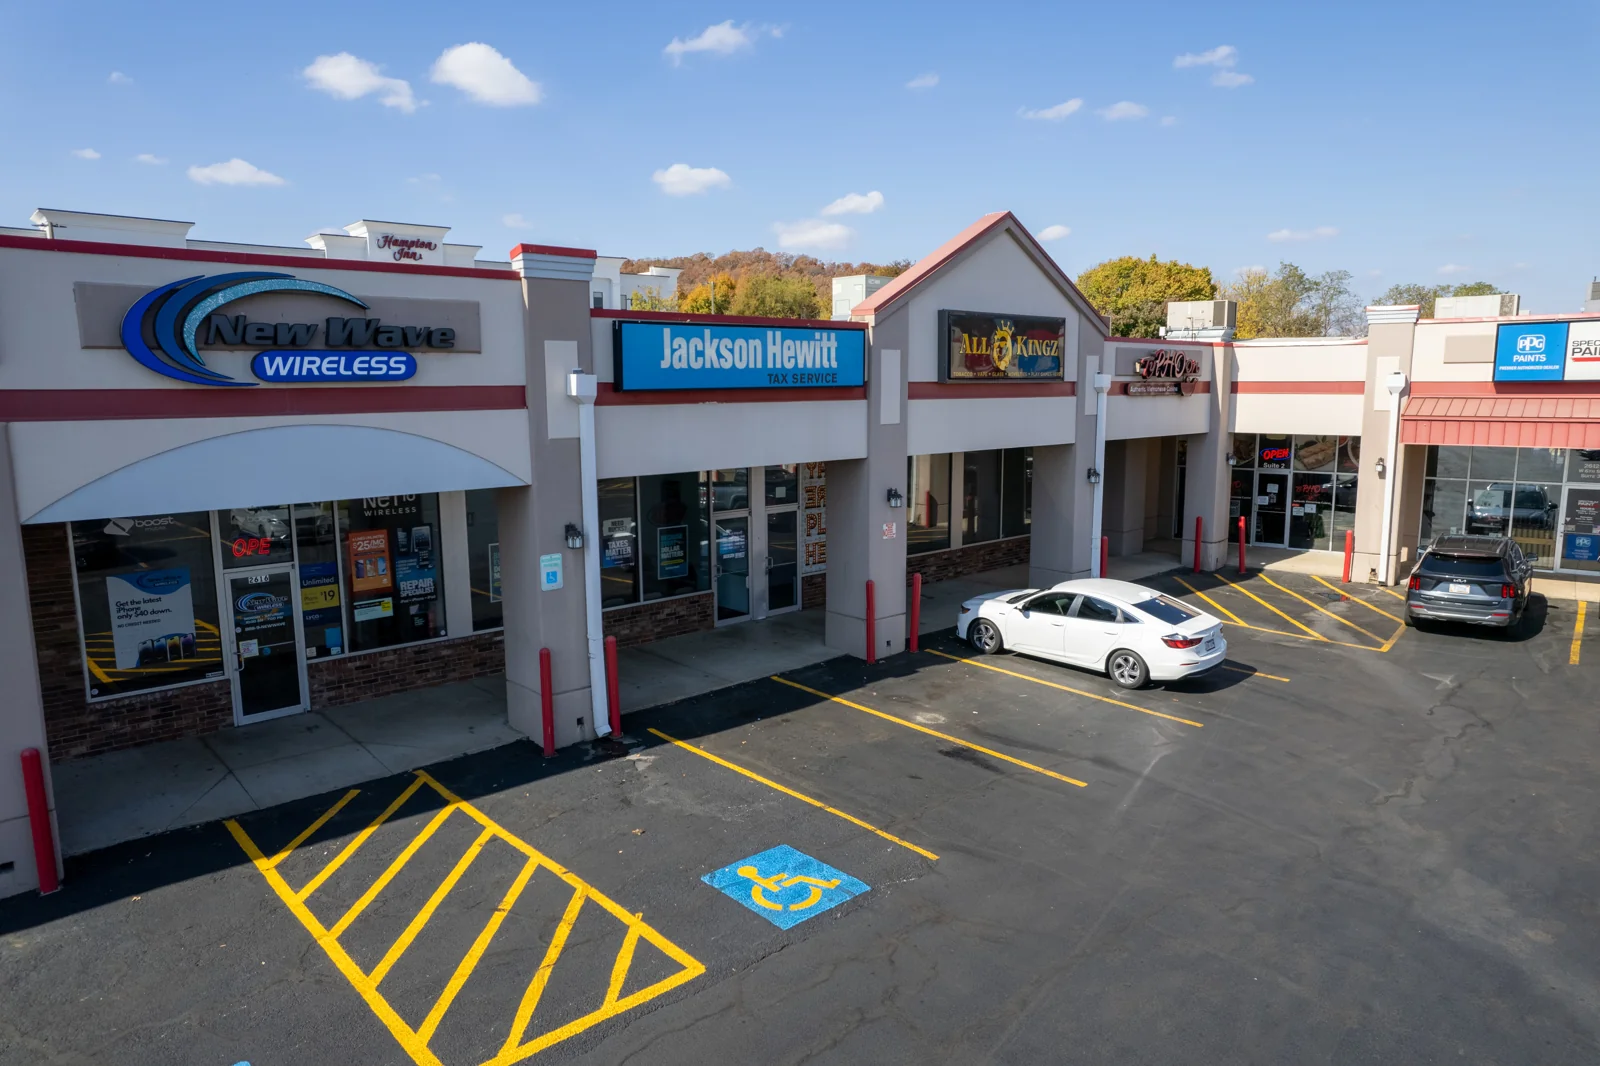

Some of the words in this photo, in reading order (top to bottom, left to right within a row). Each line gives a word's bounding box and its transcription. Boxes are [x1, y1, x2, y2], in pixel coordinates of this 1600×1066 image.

[377, 235, 437, 250] Hampton
[393, 248, 423, 261] Inn
[207, 314, 318, 346] New
[325, 317, 455, 348] Wave
[661, 328, 762, 369] Jackson
[767, 331, 837, 369] Hewitt
[959, 333, 990, 354] ALL
[1016, 336, 1058, 357] KINGZ
[1519, 337, 1543, 350] PPG
[1513, 354, 1546, 362] PAINTS
[263, 356, 406, 376] WIRELESS
[767, 373, 788, 384] TAX
[792, 372, 838, 384] SERVICE
[1263, 448, 1289, 460] OPEN
[364, 507, 416, 516] WIRELESS
[135, 516, 174, 527] boost
[608, 540, 628, 548] TAXES
[606, 547, 631, 556] MATTER
[249, 575, 268, 584] 2616
[302, 576, 334, 586] Unlimited
[400, 578, 434, 591] REPAIR
[400, 586, 434, 598] SPECIALIST
